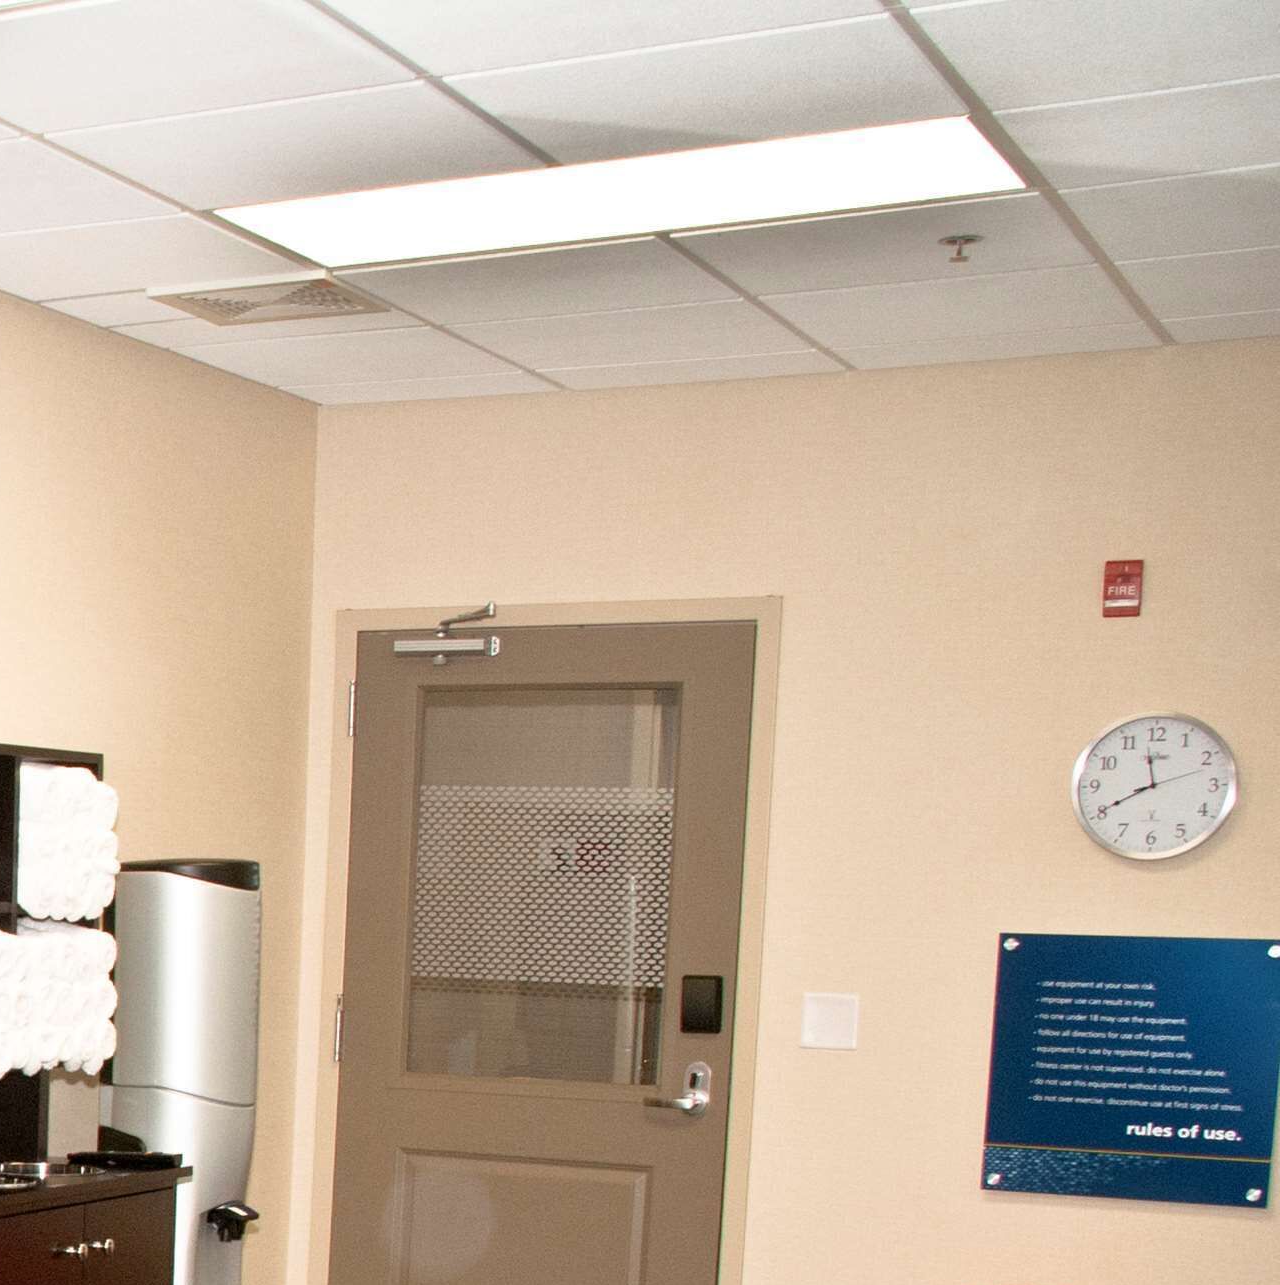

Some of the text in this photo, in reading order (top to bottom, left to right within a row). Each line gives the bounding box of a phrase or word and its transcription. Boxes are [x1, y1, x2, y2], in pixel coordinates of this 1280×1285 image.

[1107, 586, 1136, 596] FIRE
[1147, 727, 1167, 742] 12
[1181, 733, 1189, 747] 1
[1121, 736, 1135, 750] 11
[1100, 756, 1117, 770] 10
[1201, 751, 1212, 766] 2
[1089, 779, 1101, 793] 9
[1208, 778, 1219, 792] 3
[1097, 805, 1107, 820] 8
[1197, 802, 1208, 816] 4
[1118, 823, 1129, 838] 7
[1146, 830, 1156, 845] 6
[1175, 824, 1186, 838] 5
[1126, 1122, 1243, 1141] rules of use.
